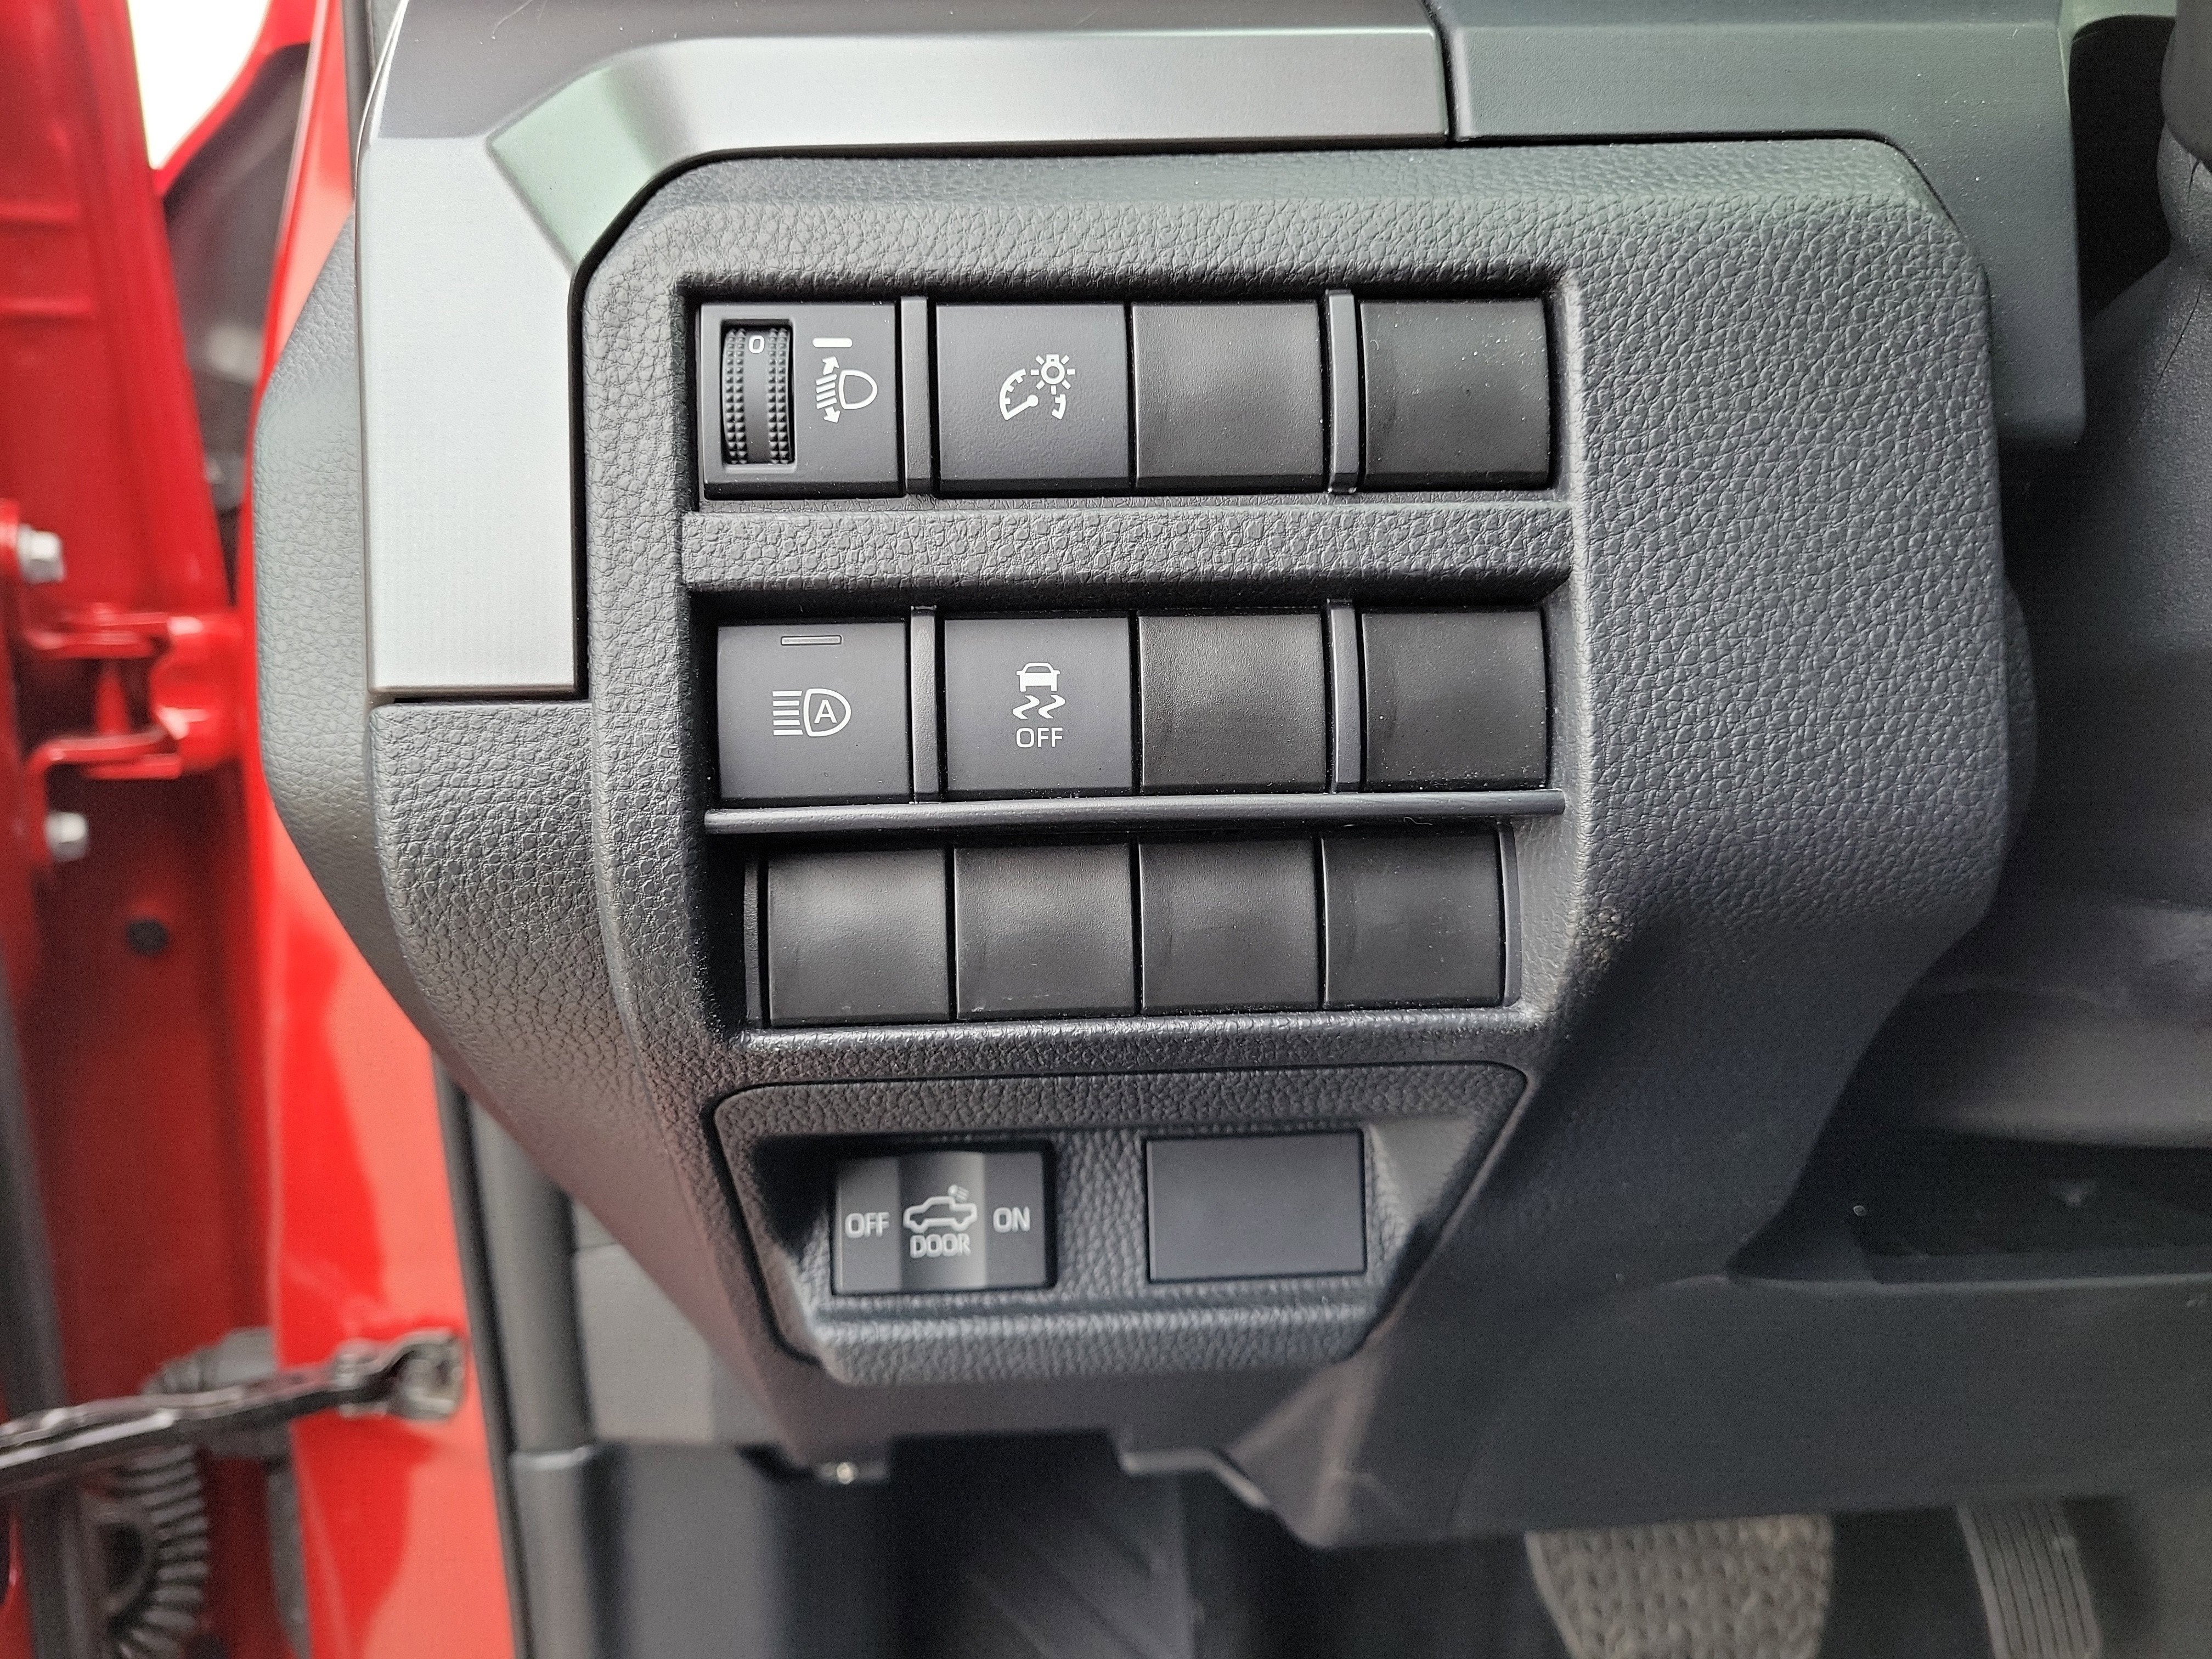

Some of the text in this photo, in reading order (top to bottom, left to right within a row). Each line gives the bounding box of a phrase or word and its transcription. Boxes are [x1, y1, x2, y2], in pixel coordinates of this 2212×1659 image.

[814, 699, 837, 724] A
[1015, 727, 1063, 748] OFF
[845, 1211, 890, 1239] OFF
[993, 1206, 1031, 1233] ON
[910, 1233, 971, 1259] DOOR
